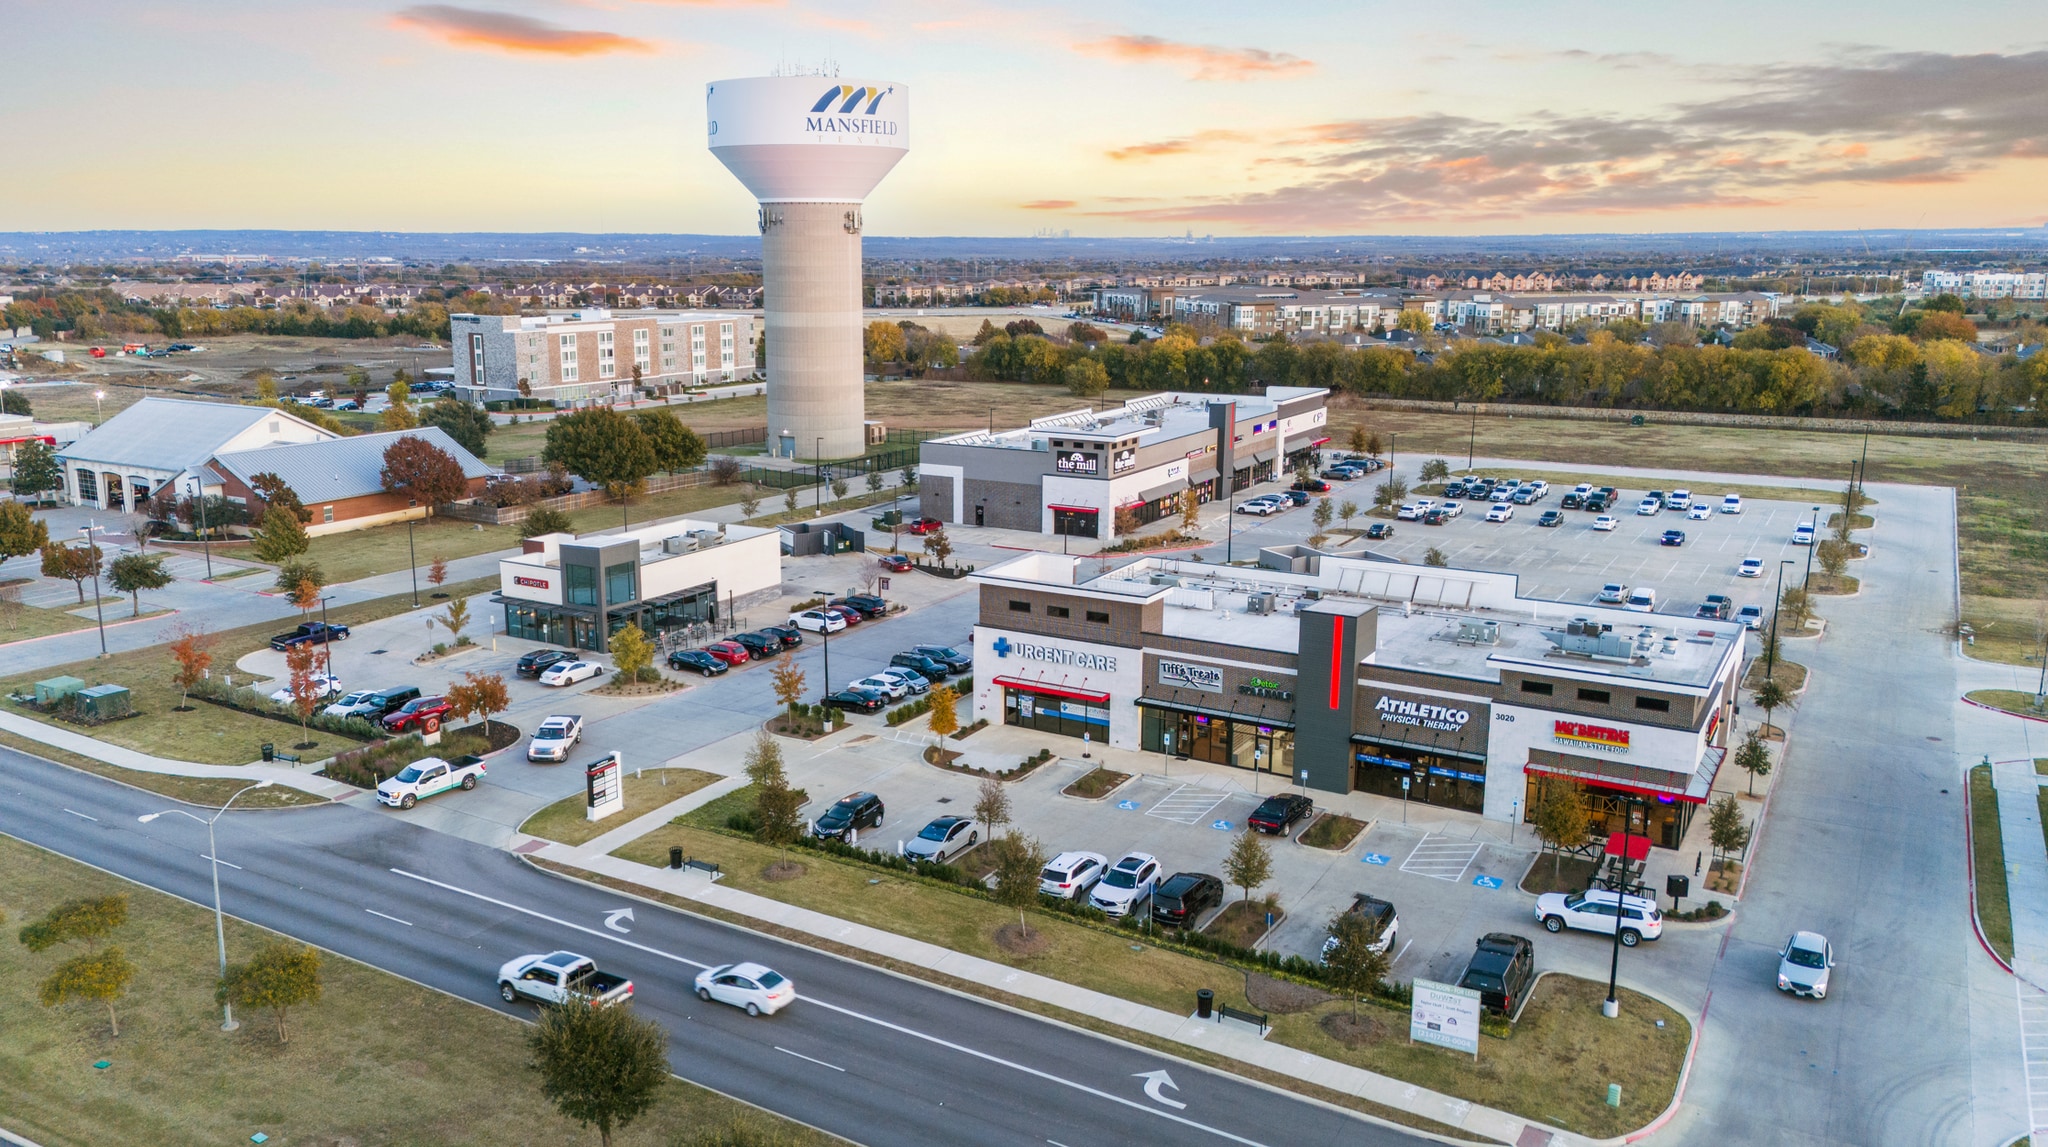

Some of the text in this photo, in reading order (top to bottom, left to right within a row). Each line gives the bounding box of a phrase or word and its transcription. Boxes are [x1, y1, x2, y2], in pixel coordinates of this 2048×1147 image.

[805, 117, 897, 135] MANSFIELD
[1057, 457, 1075, 469] the
[1076, 459, 1097, 471] mill
[1114, 458, 1125, 469] the
[186, 483, 192, 493] 3
[520, 578, 547, 588] CHIPOTLE
[1014, 643, 1117, 672] URGENT CARE
[1160, 662, 1220, 681] Tiff's Treats
[1250, 677, 1280, 689] Detox
[1375, 696, 1470, 724] ATHLETICO
[1495, 713, 1515, 723] 3020
[1381, 713, 1463, 732] PHYSICAL THERAPY
[1554, 737, 1629, 755] HAWAIIAN STYLE FOOD
